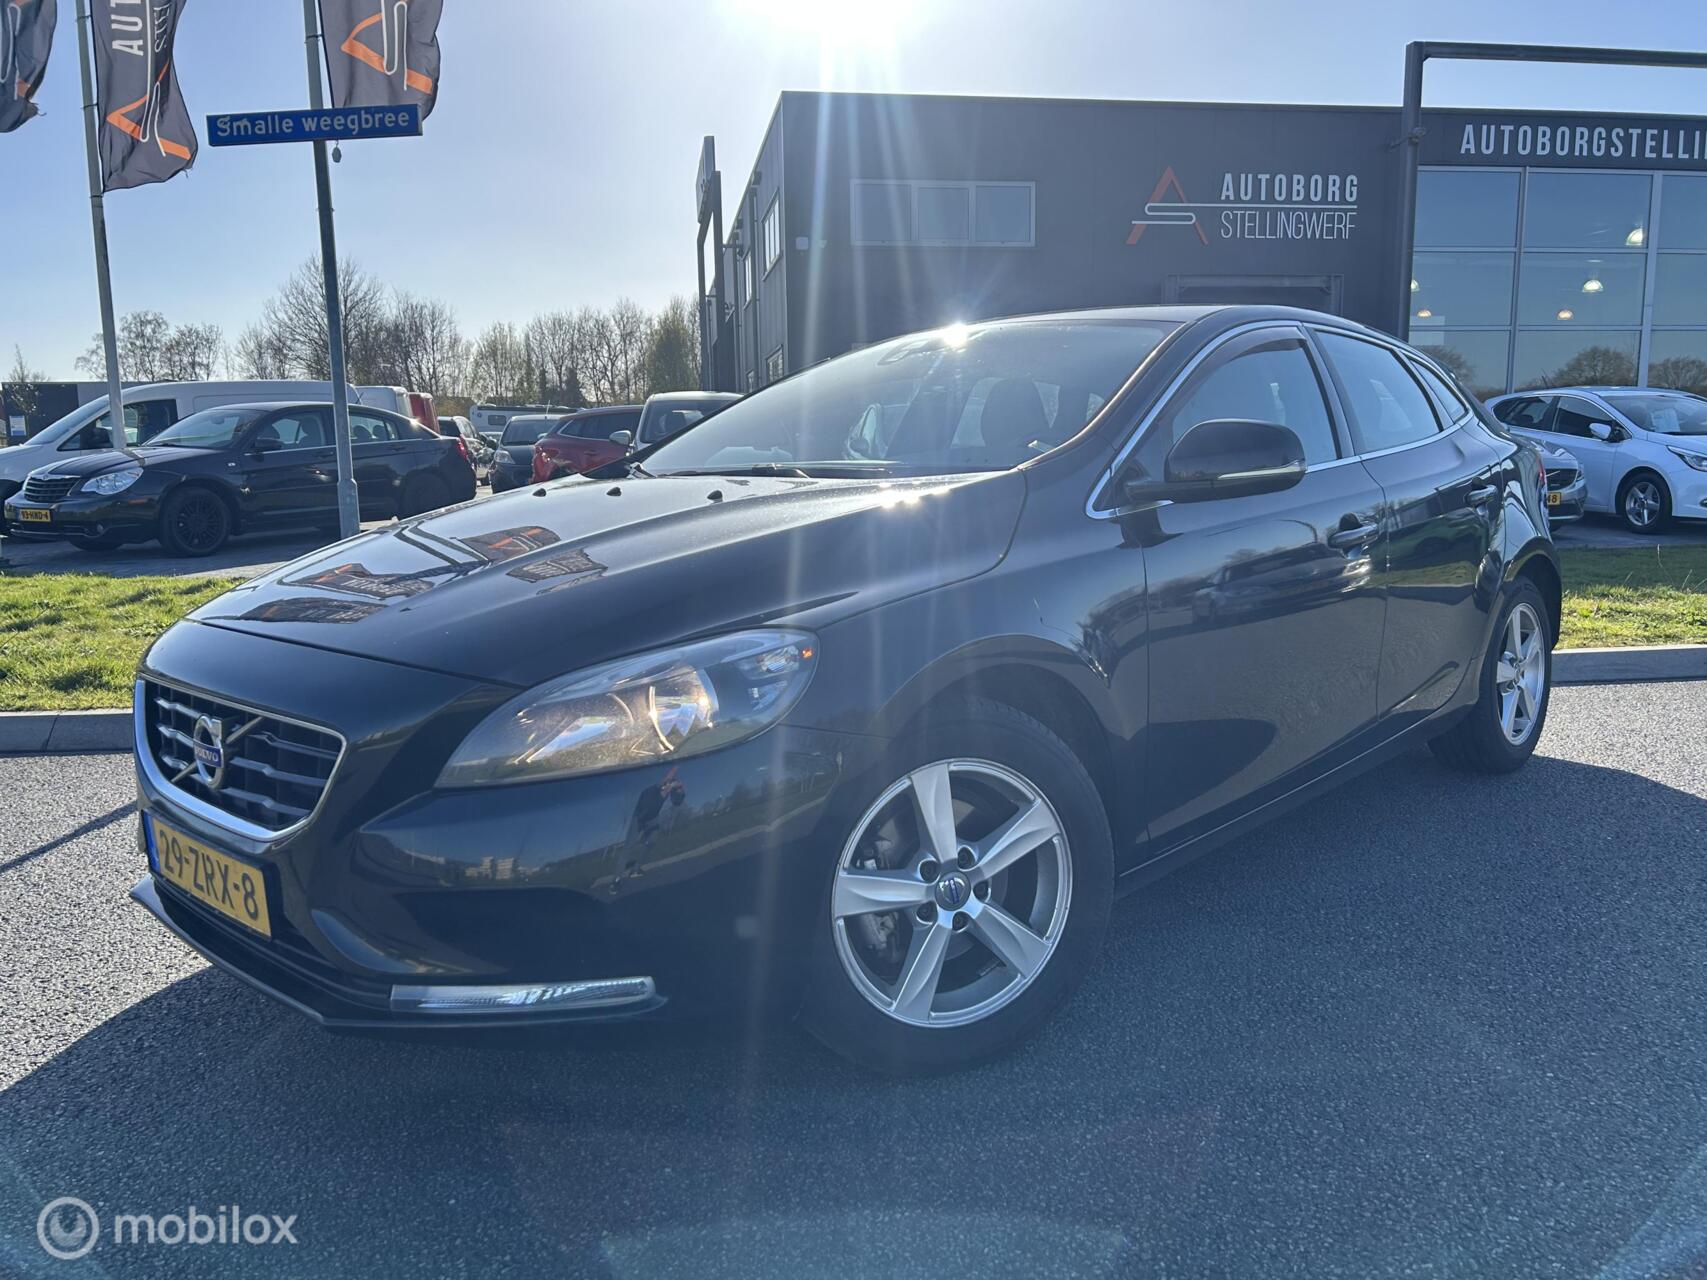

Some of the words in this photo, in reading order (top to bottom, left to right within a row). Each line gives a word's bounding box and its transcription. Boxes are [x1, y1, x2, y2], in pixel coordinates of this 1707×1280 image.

[216, 114, 294, 137] Smalle
[301, 110, 410, 134] weegbree
[1460, 124, 1707, 160] AUTOBORGSTELLI
[1220, 173, 1358, 202] AUTOBORG
[1220, 210, 1358, 239] STELLINGWERF
[159, 829, 259, 920] 29-ZRX-8
